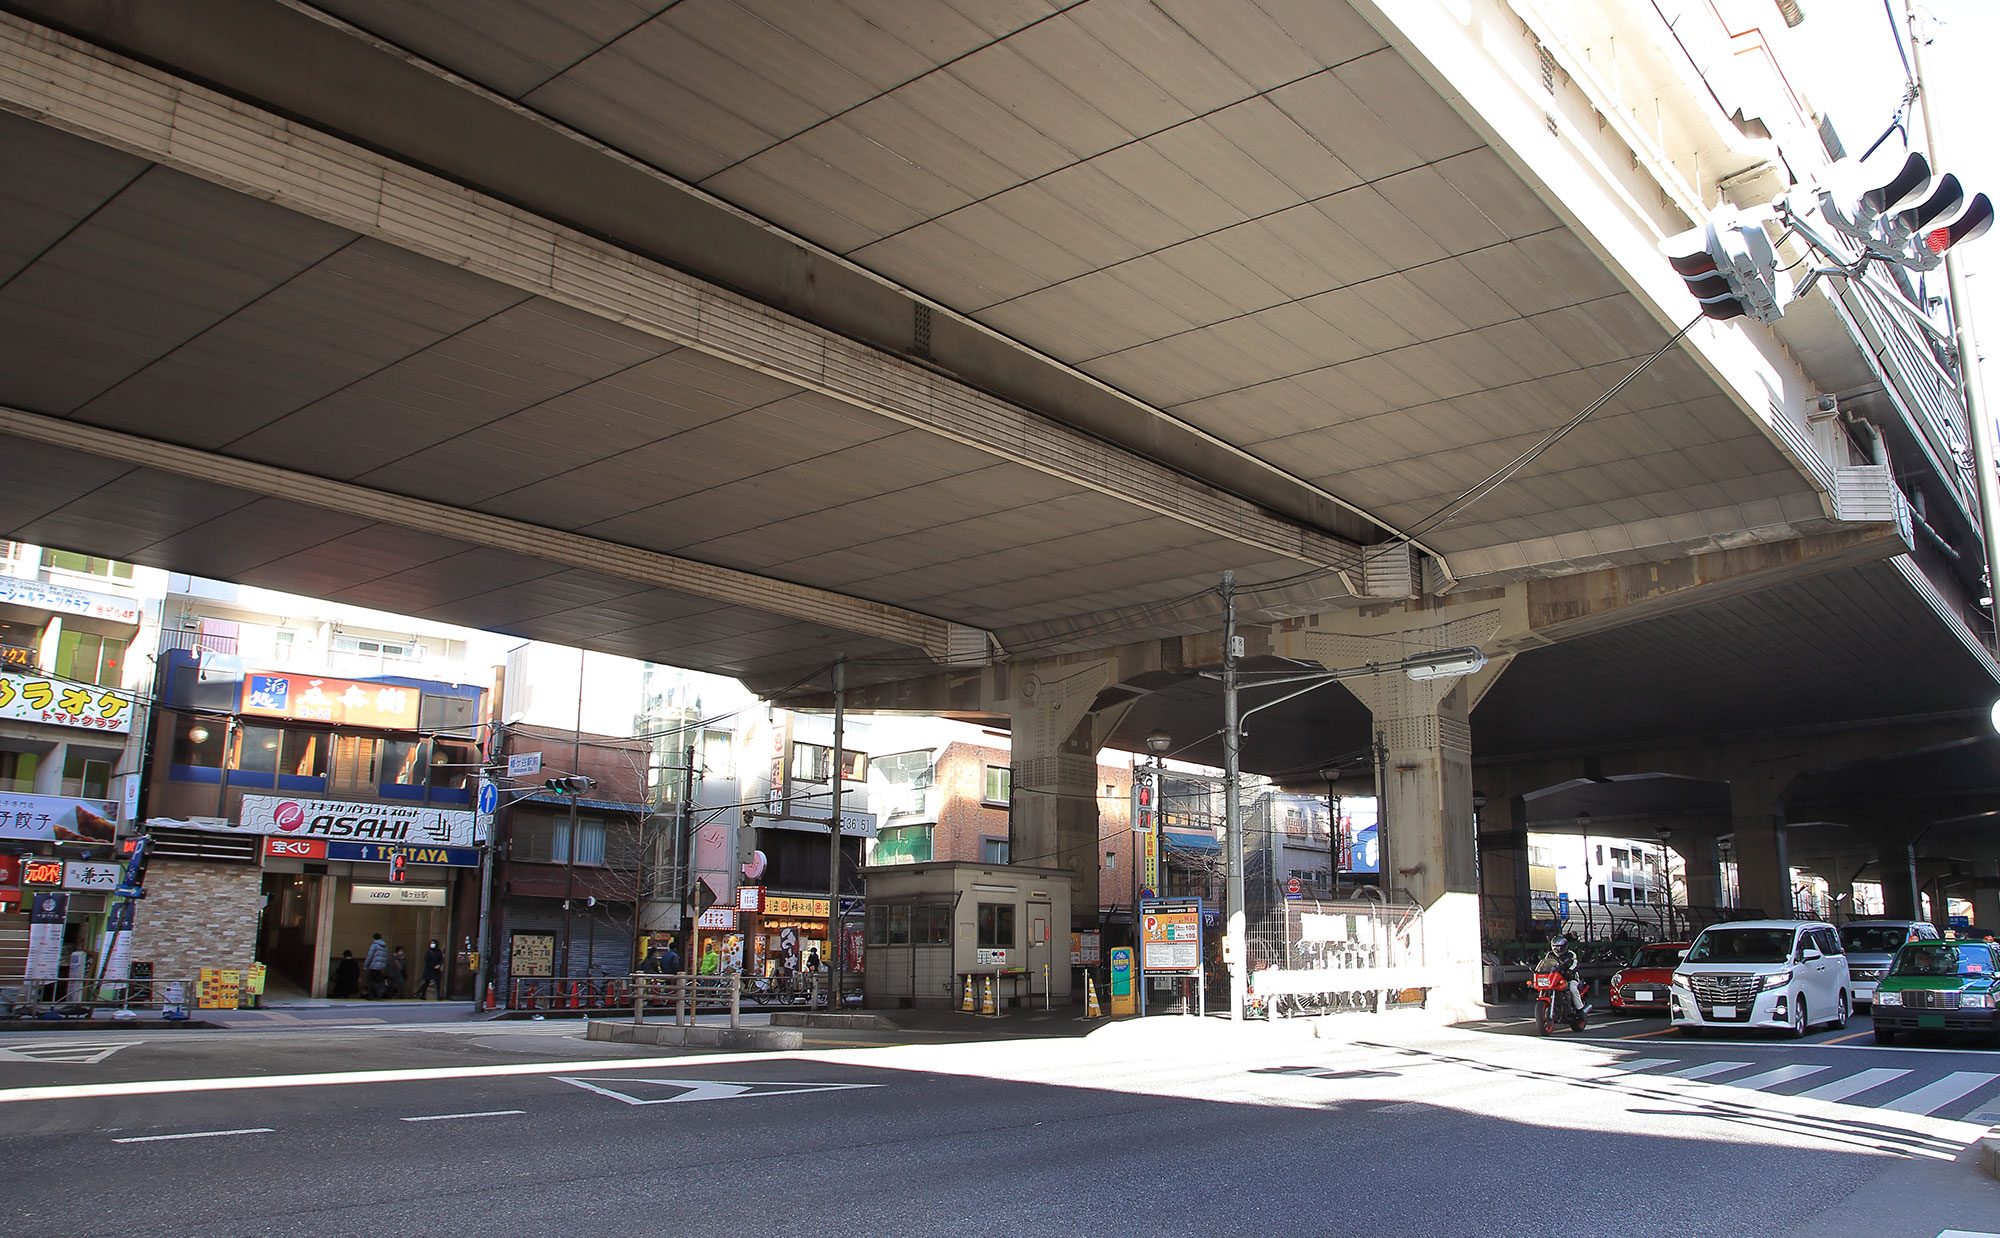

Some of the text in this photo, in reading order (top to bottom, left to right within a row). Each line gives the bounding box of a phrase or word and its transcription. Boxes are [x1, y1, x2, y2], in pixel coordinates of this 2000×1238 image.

[42, 709, 123, 729] トマトクラブ
[308, 815, 410, 840] ASAHI
[272, 842, 311, 855] 宝くじ
[377, 846, 449, 863] TSTAYA
[80, 867, 115, 884] 兼六
[370, 891, 391, 899] KEIO
[1147, 917, 1156, 930] P
